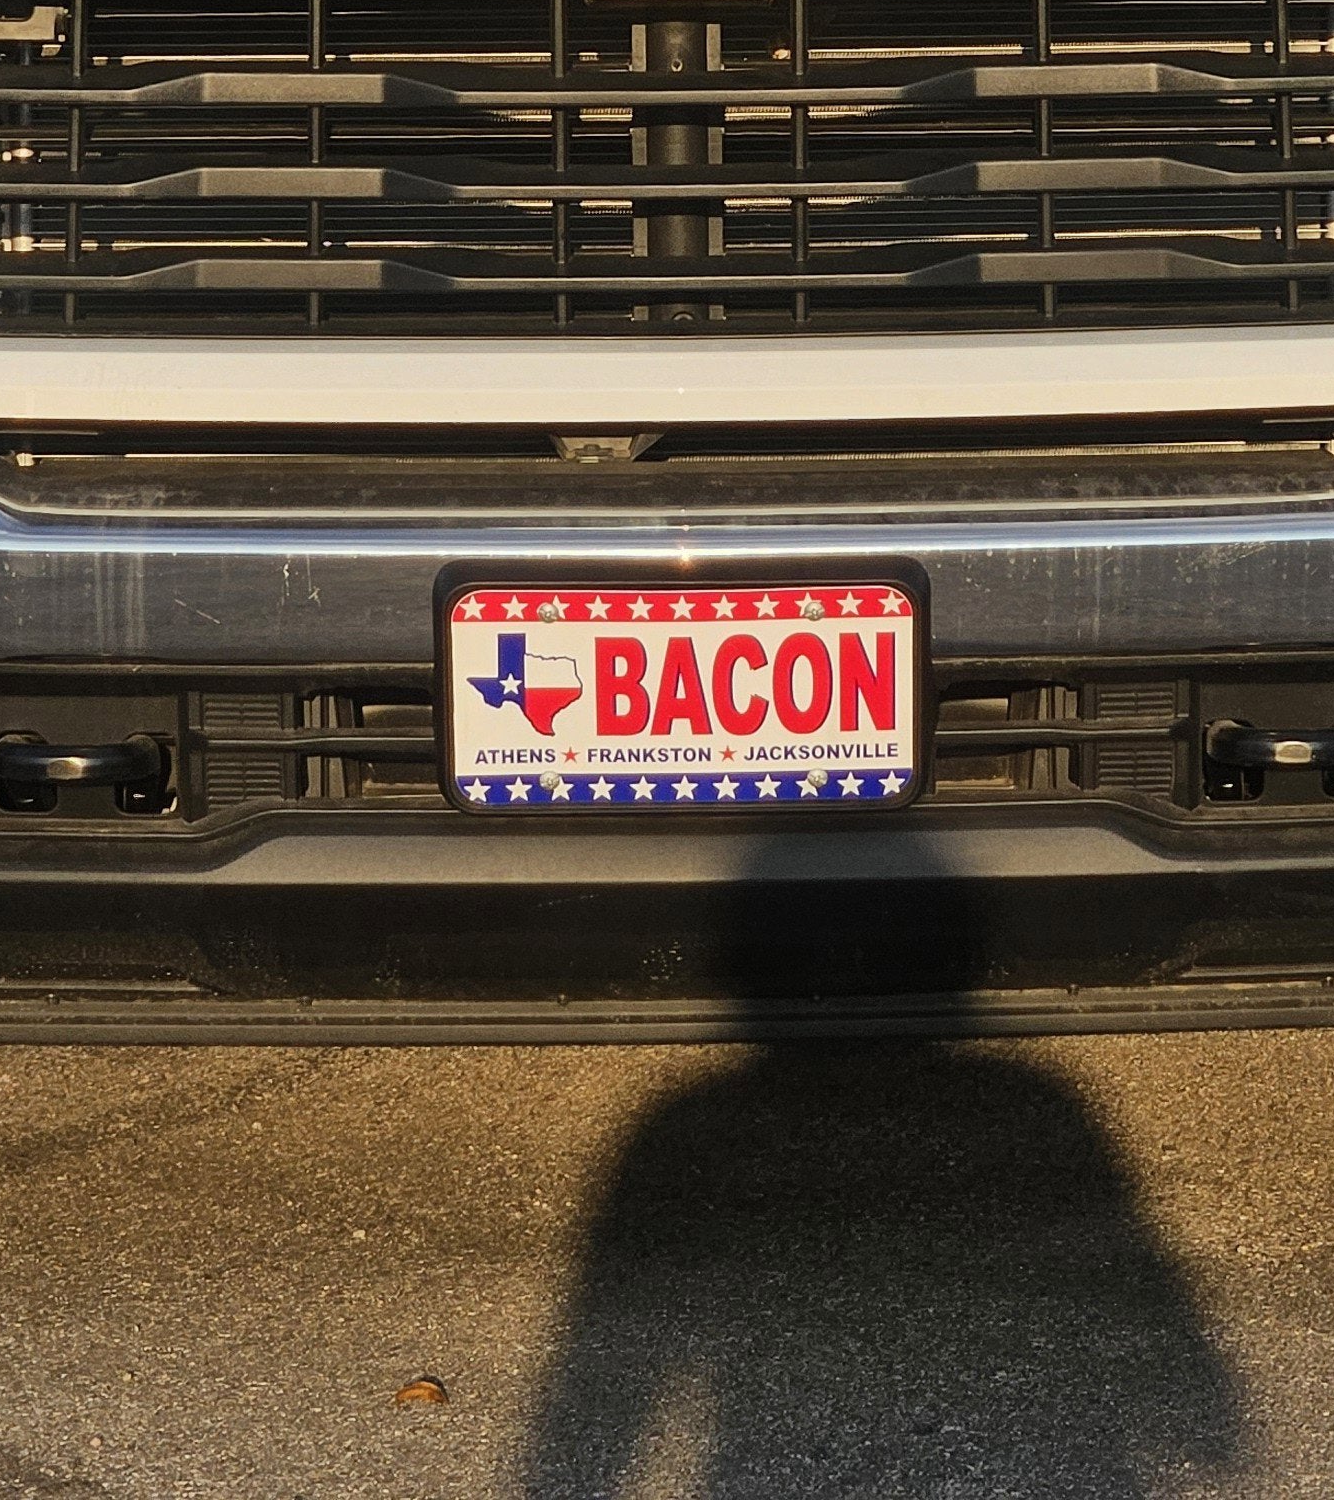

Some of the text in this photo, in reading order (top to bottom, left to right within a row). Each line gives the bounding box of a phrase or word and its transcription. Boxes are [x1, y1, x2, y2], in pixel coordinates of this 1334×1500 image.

[594, 631, 897, 737] BACON
[474, 743, 899, 764] ATHENS FRANKSTON JACKSONVILLE
